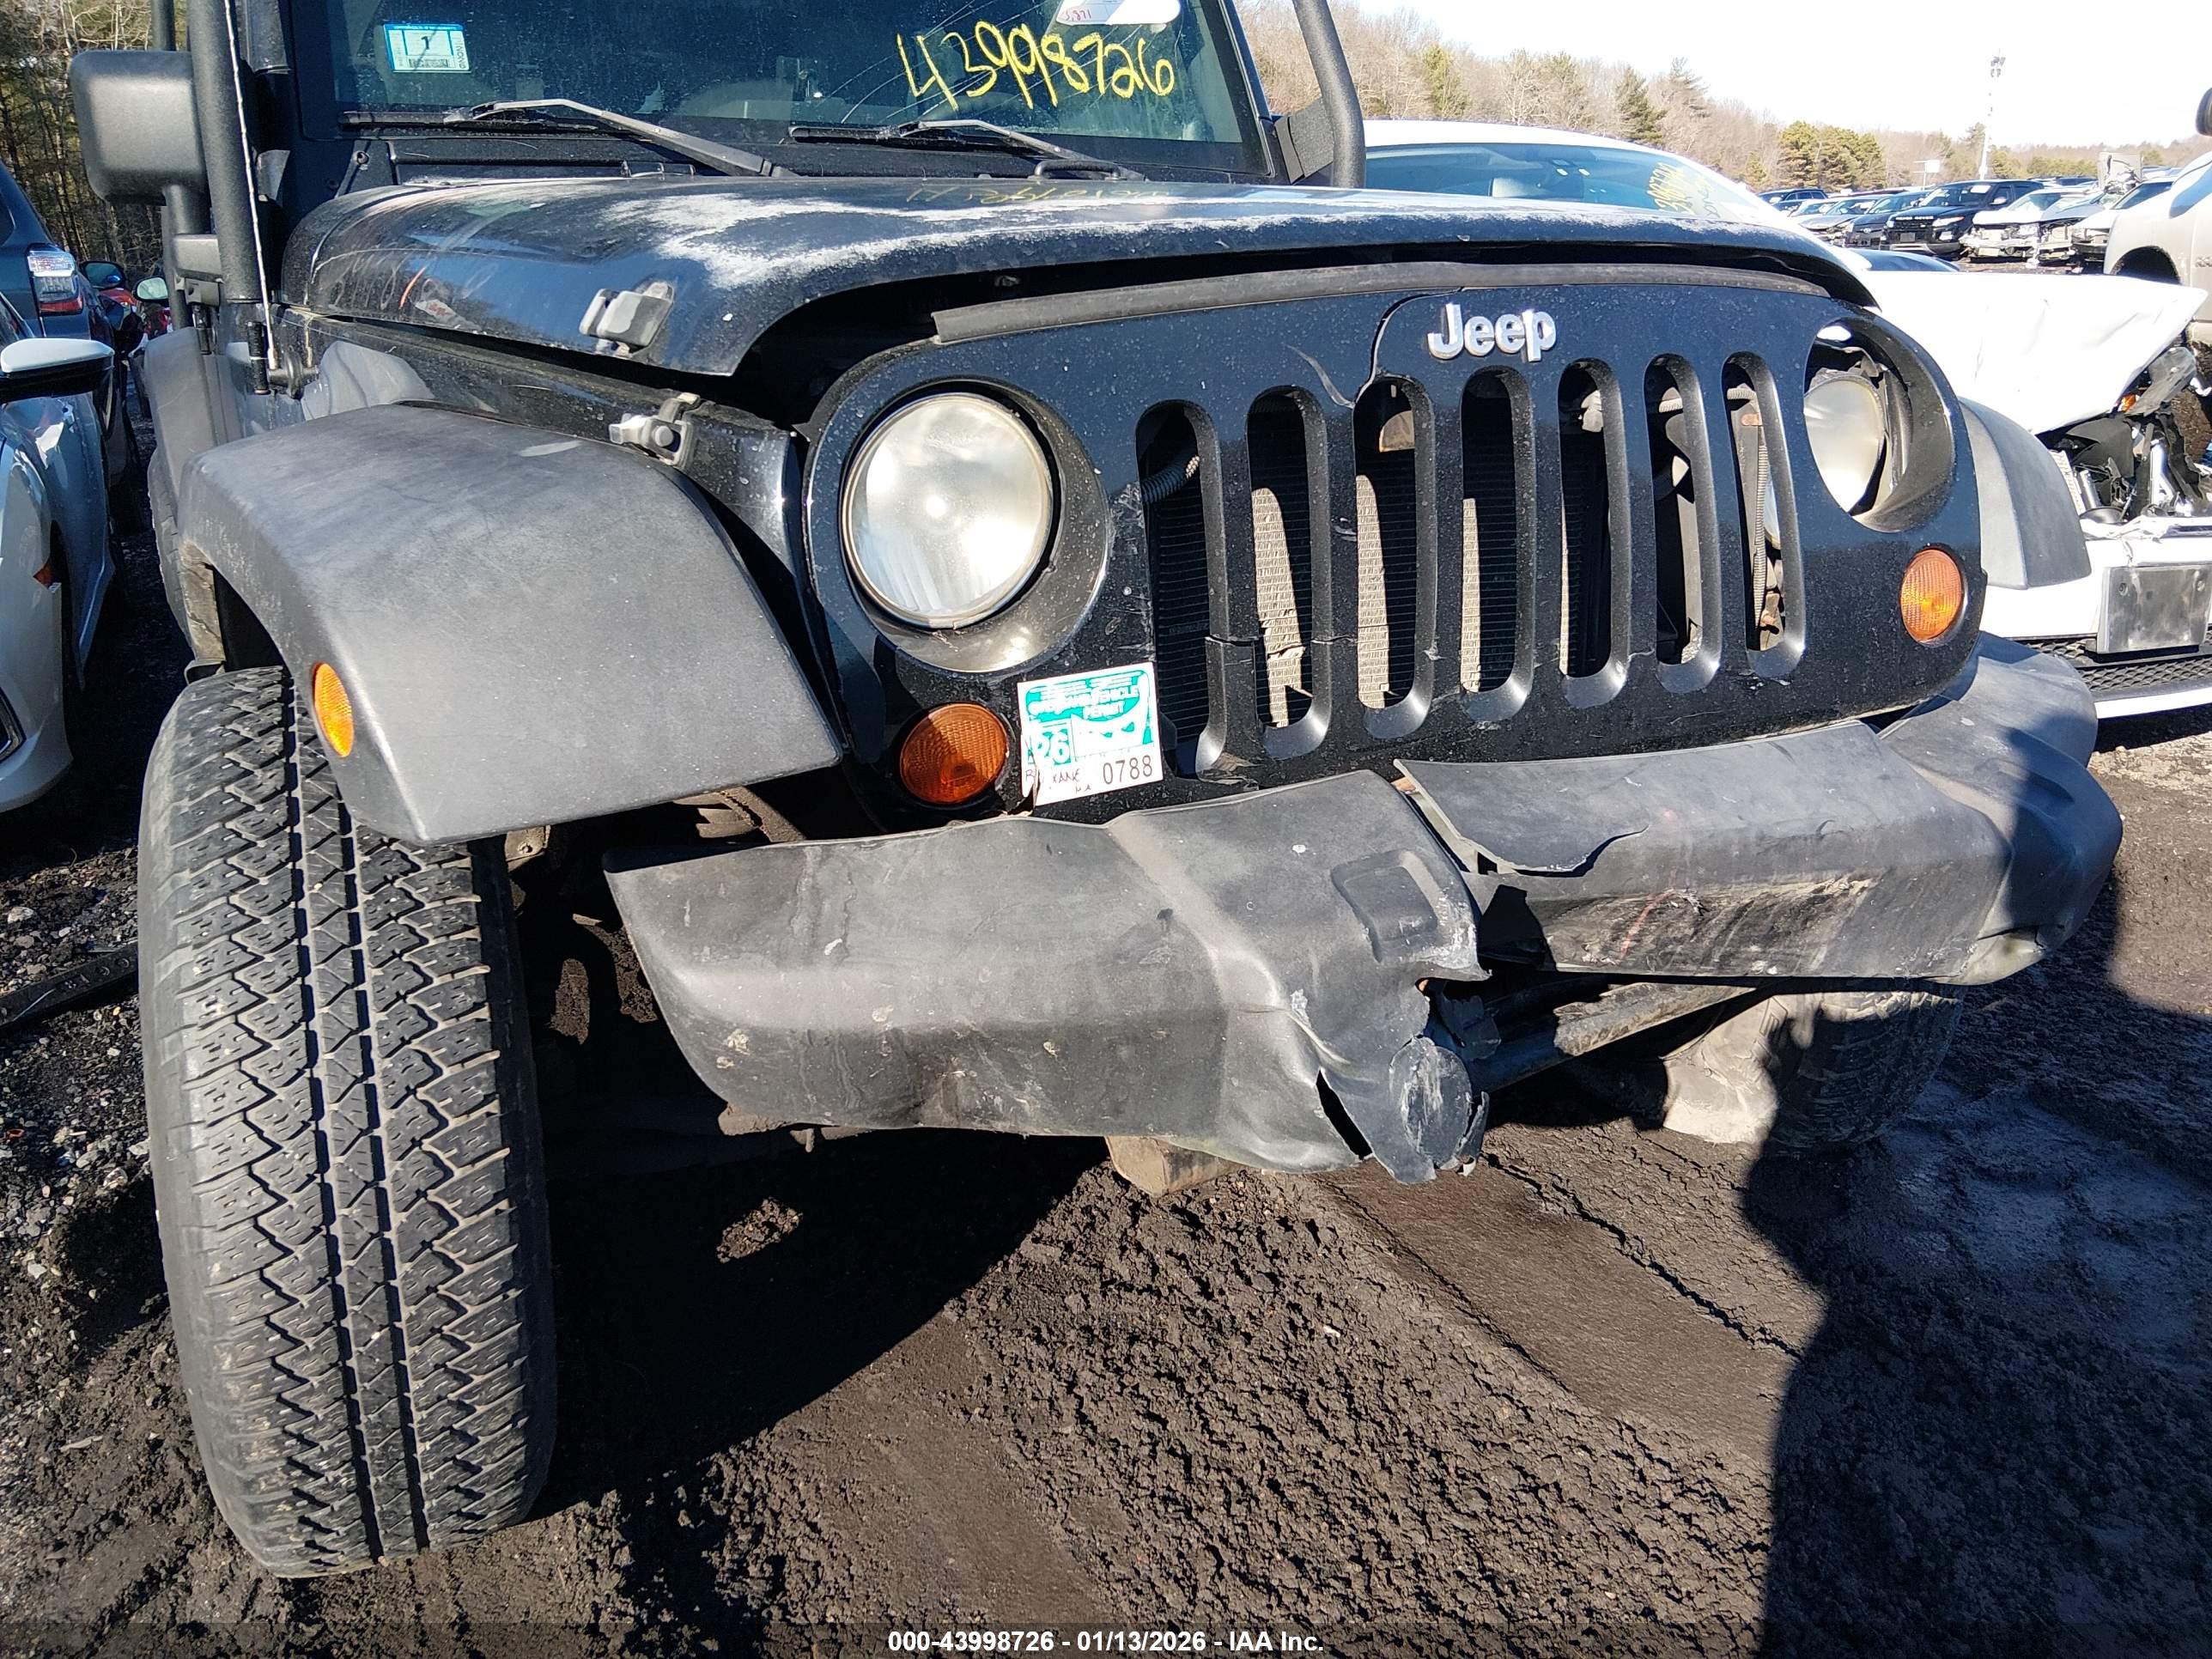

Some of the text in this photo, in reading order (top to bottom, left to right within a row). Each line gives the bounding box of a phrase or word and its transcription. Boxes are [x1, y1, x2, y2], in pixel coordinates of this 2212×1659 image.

[896, 21, 1175, 111] 43998726
[1427, 302, 1557, 362] Jeep
[1103, 755, 1152, 786] 0788
